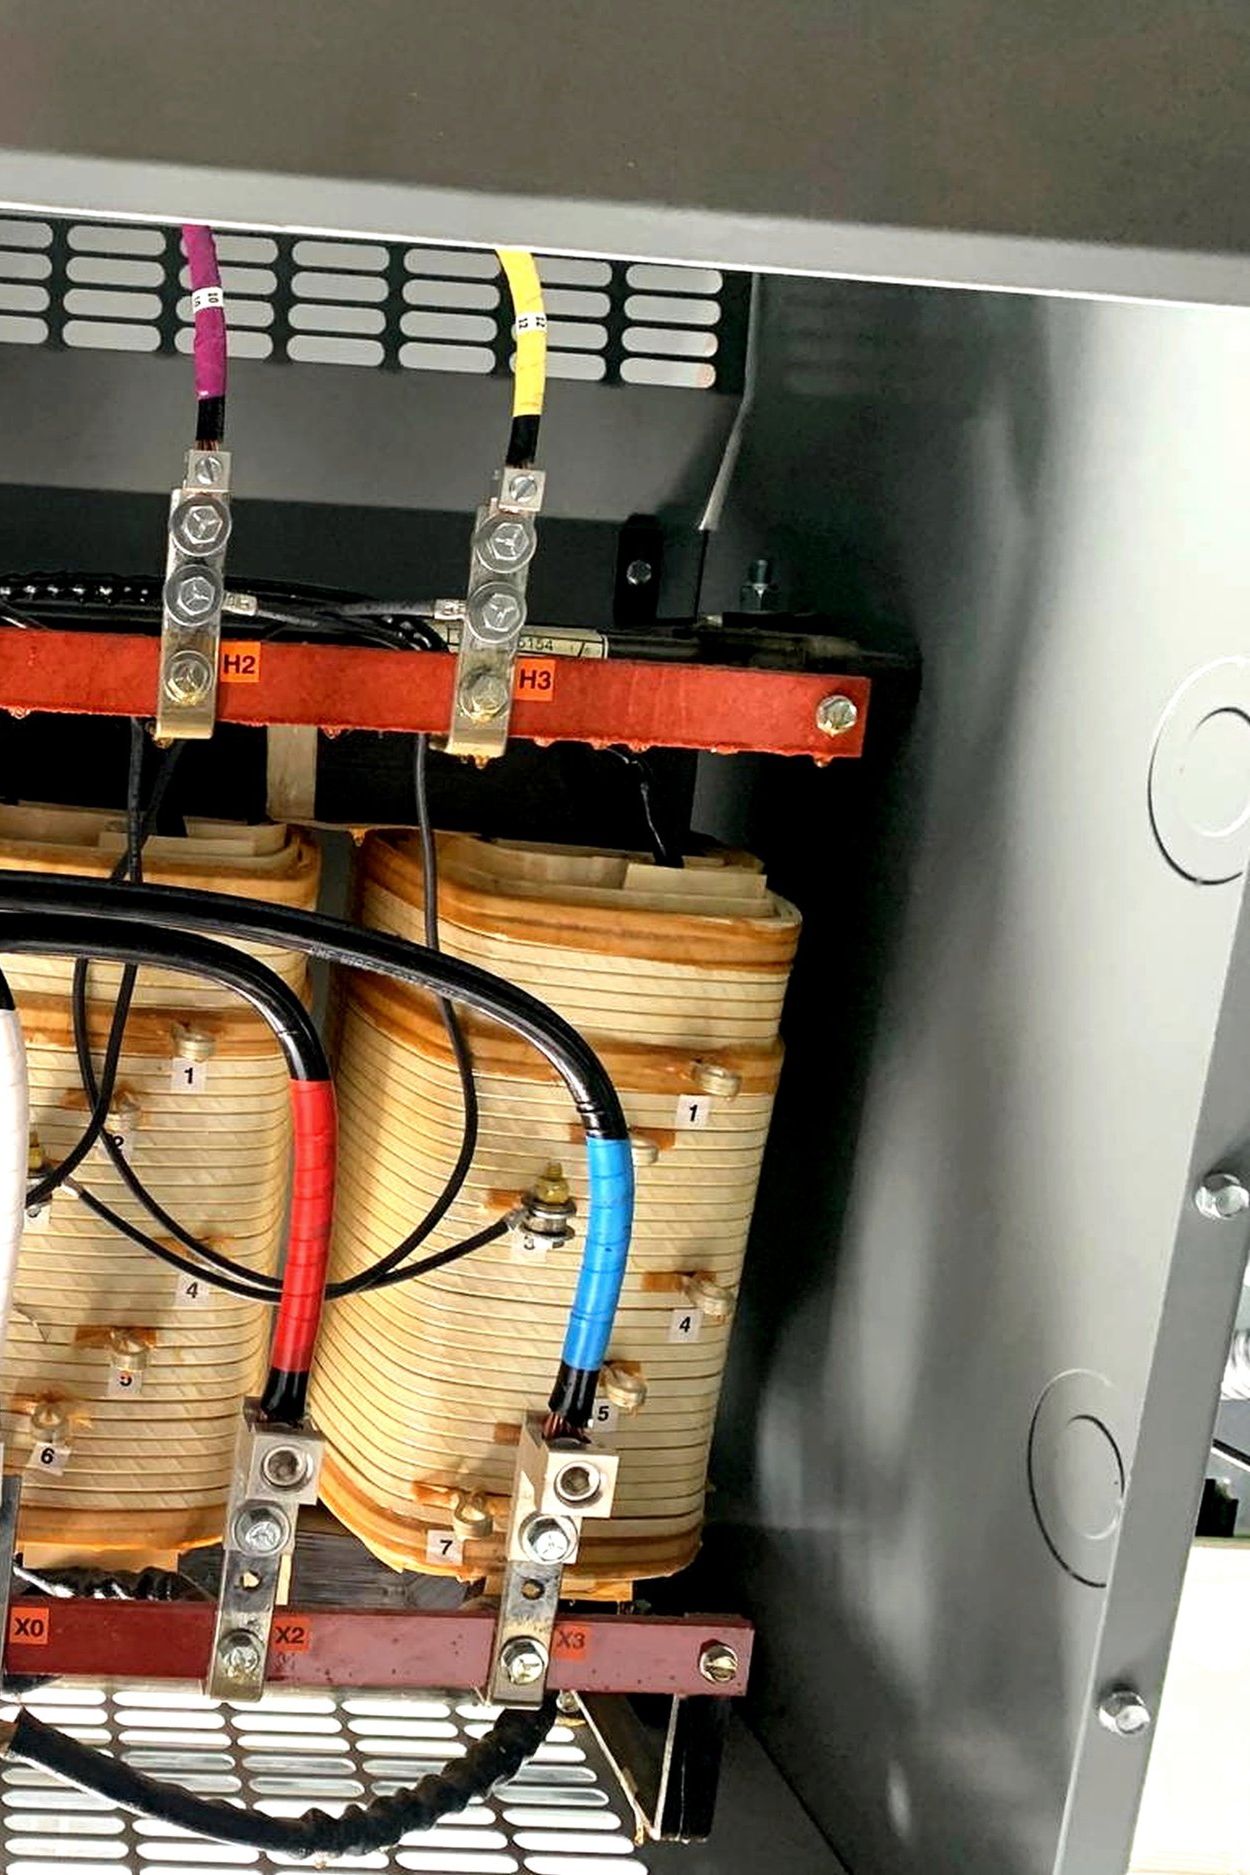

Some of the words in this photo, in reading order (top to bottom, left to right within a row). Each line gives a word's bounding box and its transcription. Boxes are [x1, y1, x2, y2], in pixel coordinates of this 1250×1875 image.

[224, 653, 256, 674] H2
[519, 669, 552, 690] H3
[184, 1066, 193, 1084] 1
[689, 1103, 698, 1122] 1
[186, 1281, 198, 1299] 4
[679, 1315, 691, 1333] 4
[597, 1405, 610, 1422] 5
[40, 1447, 55, 1465] 6
[439, 1538, 453, 1555] 7
[274, 1625, 305, 1645] X2
[556, 1629, 586, 1650] X3
